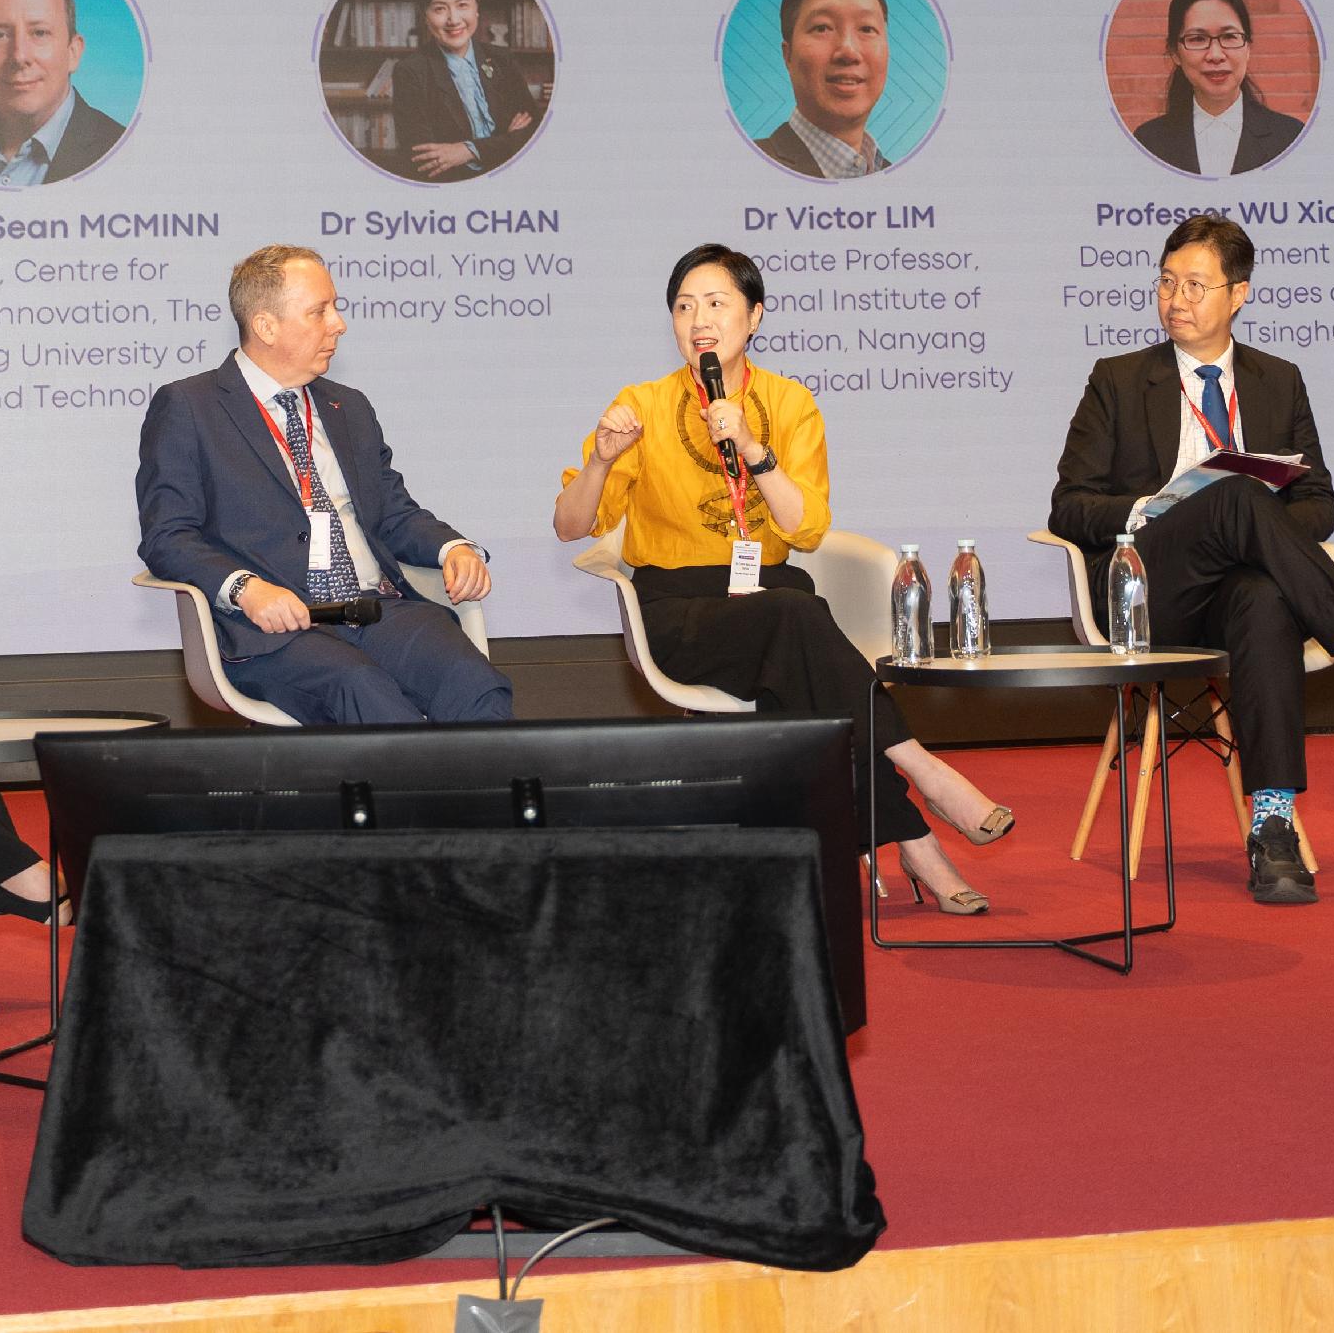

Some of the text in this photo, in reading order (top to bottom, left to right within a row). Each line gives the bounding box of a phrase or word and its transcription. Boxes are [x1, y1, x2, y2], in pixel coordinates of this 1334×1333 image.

[81, 213, 218, 238] MCMINN
[322, 210, 558, 240] Dr Sylvia CHAN
[745, 206, 934, 230] Dr Victor LIM
[1239, 202, 1288, 224] WU
[328, 254, 572, 283] rincipal, Ying Wa
[846, 247, 978, 271] Professor,
[1079, 245, 1157, 268] Dean,
[15, 259, 118, 283] Centre
[128, 257, 169, 281] for
[167, 299, 221, 321] The
[455, 293, 550, 317] School
[834, 288, 946, 311] Institute
[955, 286, 981, 309] of
[859, 329, 985, 354] Nanyang
[22, 341, 168, 369] University
[177, 340, 206, 364] of
[881, 366, 1013, 393] University
